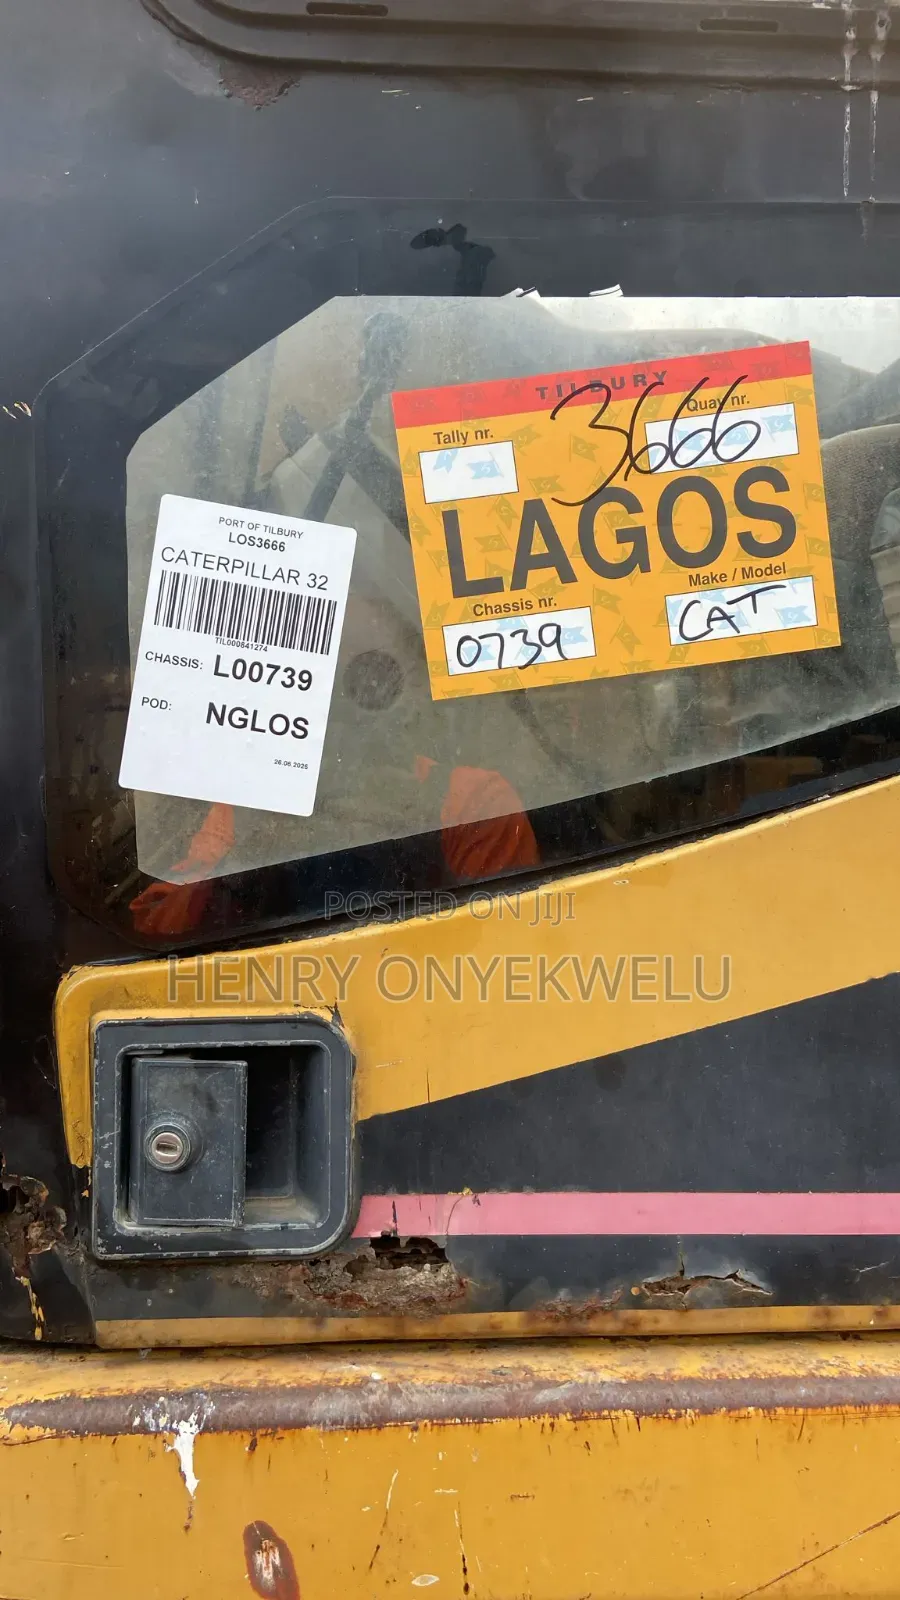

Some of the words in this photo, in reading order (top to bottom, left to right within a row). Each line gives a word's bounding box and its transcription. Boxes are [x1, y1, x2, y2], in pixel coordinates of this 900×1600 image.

[535, 370, 669, 400] TILBURY
[686, 397, 728, 413] Quay
[731, 393, 751, 406] nr.
[433, 430, 470, 446] Tally
[474, 428, 494, 441] nr.
[550, 374, 761, 506] 3666
[218, 516, 245, 529] PORT
[247, 521, 261, 532] OF
[263, 524, 304, 540] TILBURY
[228, 532, 286, 552] LOS3666
[442, 466, 797, 599] LAGOS
[161, 546, 301, 585] CATERPILLAR
[306, 573, 329, 591] 32
[688, 571, 729, 588] Make
[741, 561, 787, 580] Model
[472, 597, 534, 617] Chassis
[538, 594, 558, 609] nr.
[678, 584, 786, 641] CAT
[456, 623, 569, 670] 0739
[145, 650, 204, 670] CHASSIS:
[213, 654, 313, 691] L00739
[141, 696, 172, 711] POD:
[205, 702, 310, 740] NGLOS
